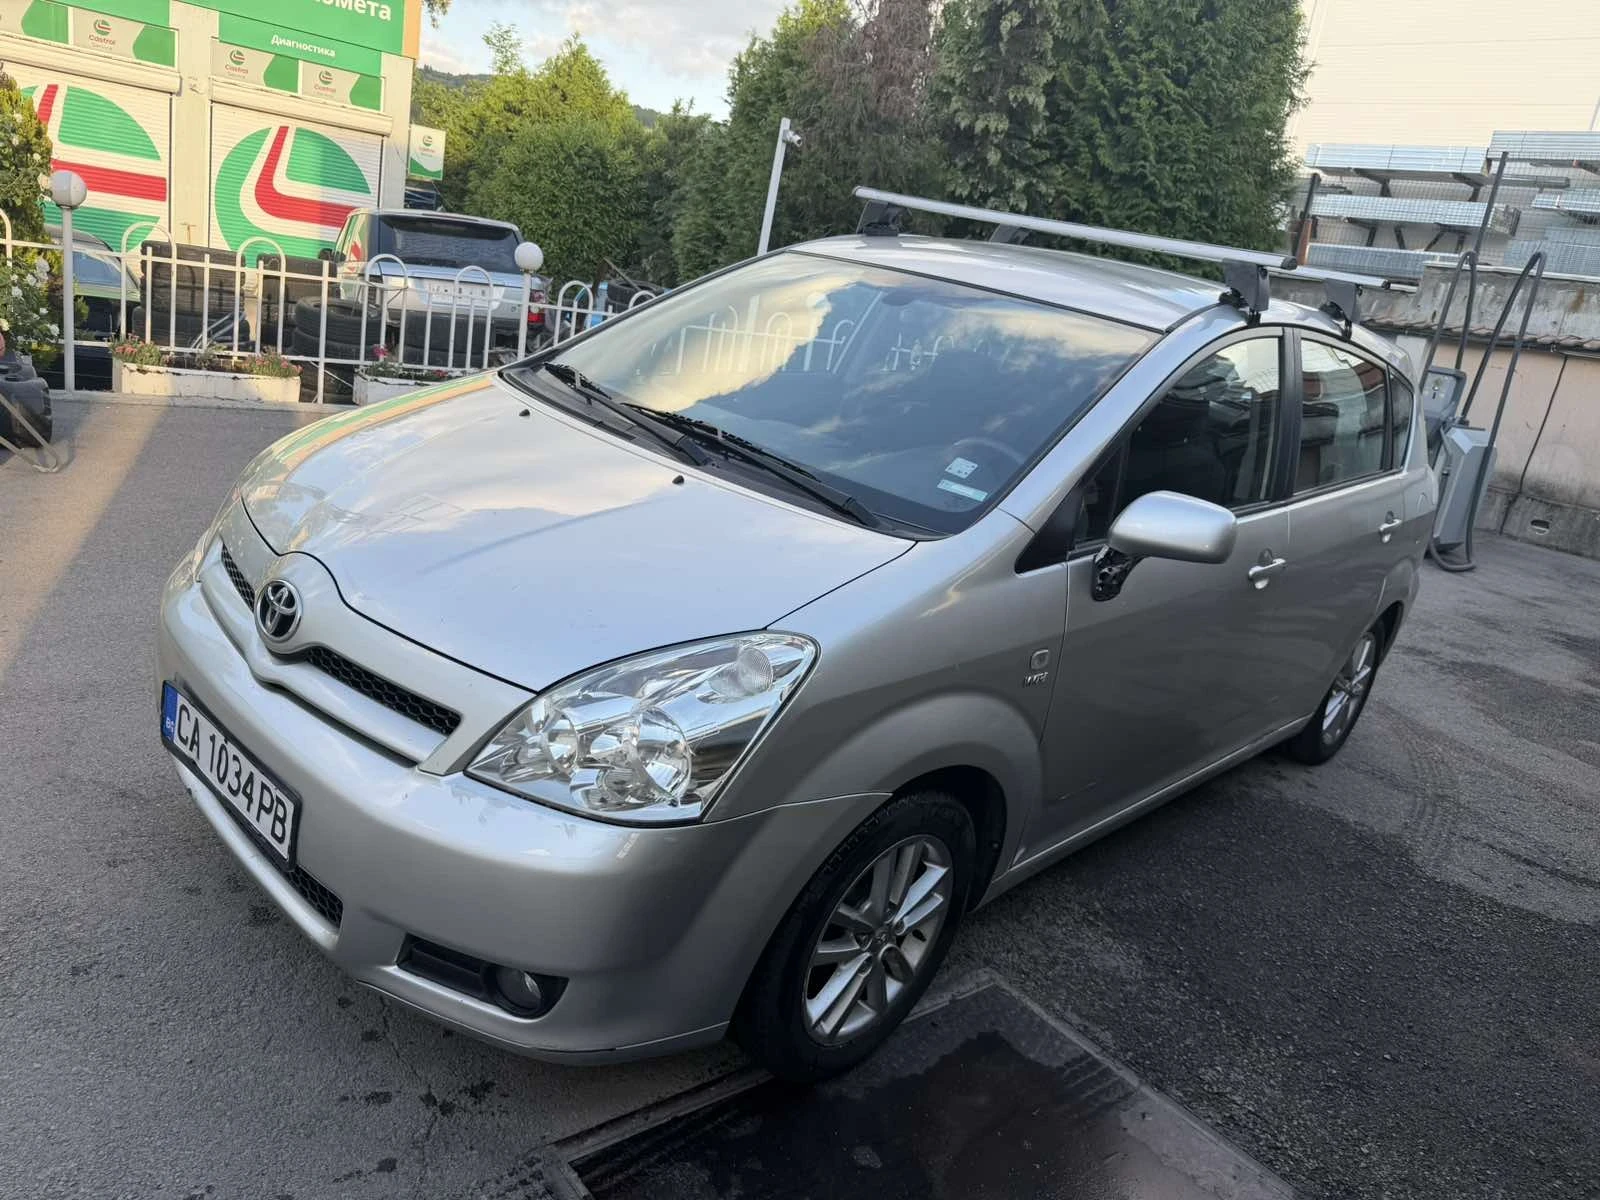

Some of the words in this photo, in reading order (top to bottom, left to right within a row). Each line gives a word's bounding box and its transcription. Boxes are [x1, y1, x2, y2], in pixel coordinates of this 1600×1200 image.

[315, 0, 391, 21] мета
[271, 34, 335, 57] Диагностика
[177, 704, 200, 760] CA
